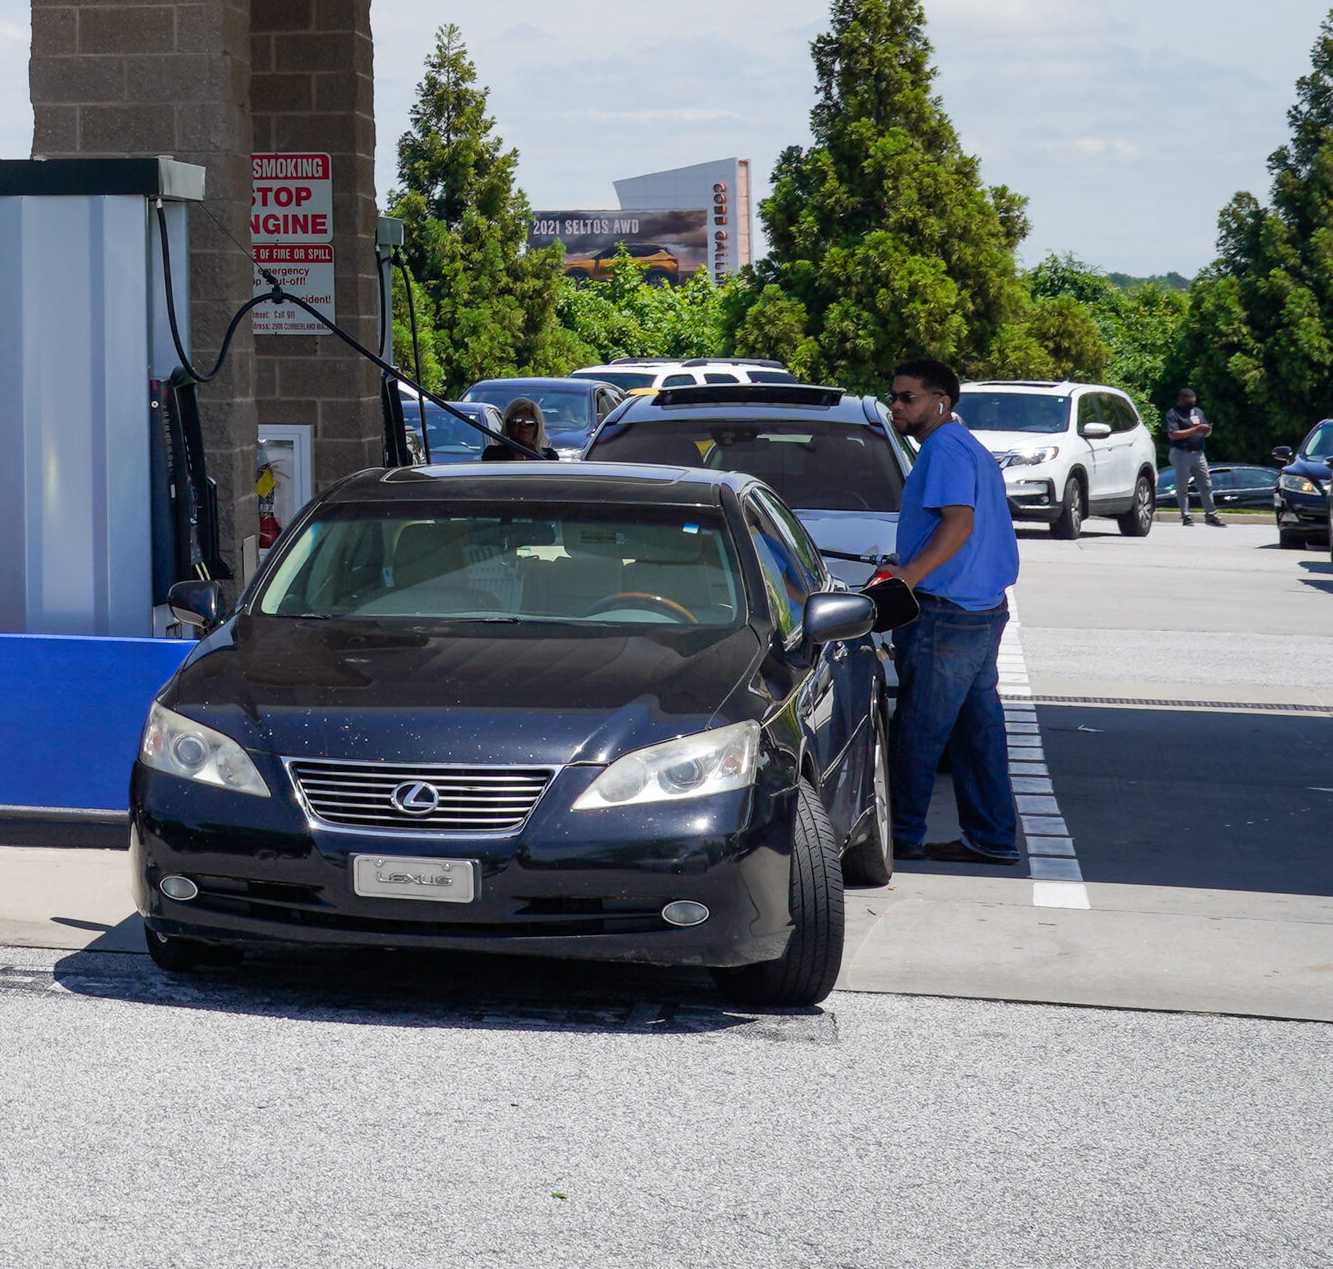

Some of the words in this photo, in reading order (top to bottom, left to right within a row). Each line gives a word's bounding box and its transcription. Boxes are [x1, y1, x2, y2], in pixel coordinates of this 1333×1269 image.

[253, 158, 323, 178] SMOKING
[251, 186, 312, 207] TOP
[250, 214, 327, 234] NGINE
[533, 220, 560, 235] 2021
[565, 220, 609, 234] SELTOS
[613, 218, 640, 234] AWD
[260, 248, 270, 260] OF
[273, 248, 291, 260] FIRE
[294, 248, 305, 260] OR
[308, 248, 331, 260] SPILL
[376, 872, 453, 886] LEXUS
